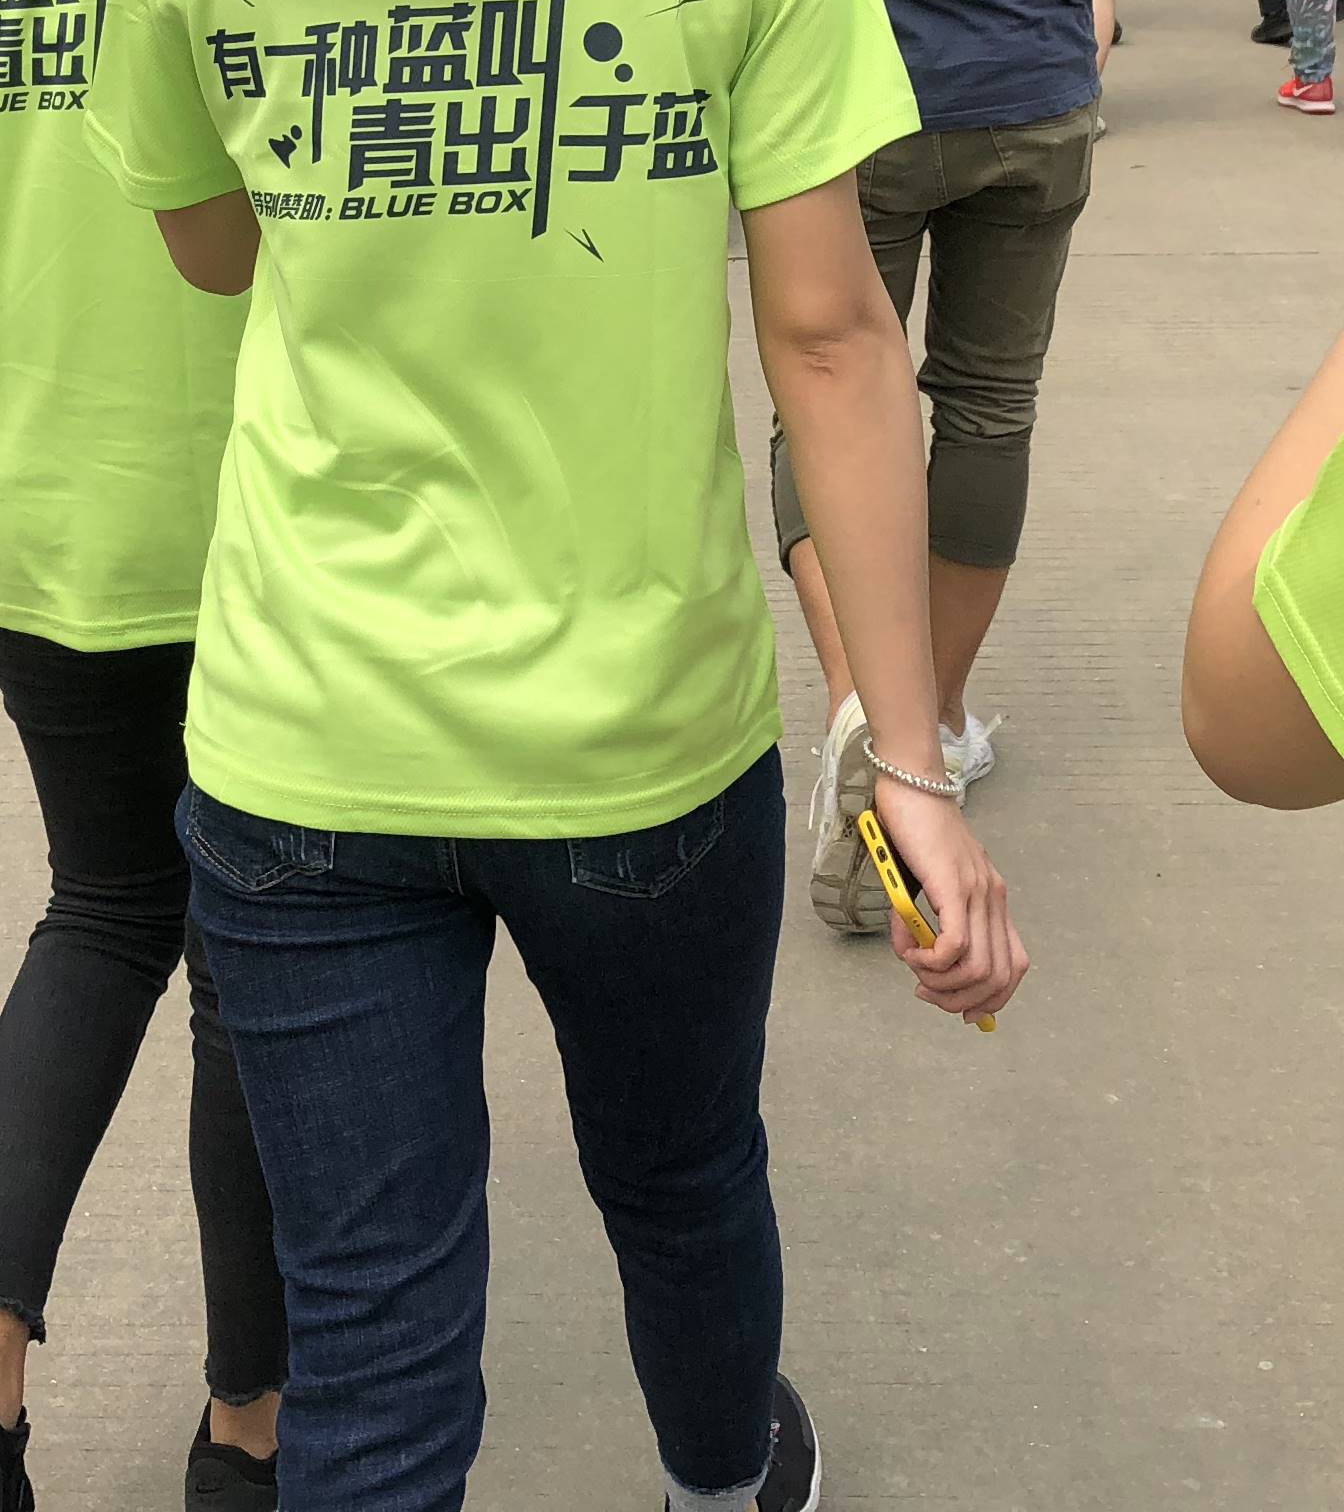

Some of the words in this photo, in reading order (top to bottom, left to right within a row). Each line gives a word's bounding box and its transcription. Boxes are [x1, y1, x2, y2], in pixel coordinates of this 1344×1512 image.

[38, 90, 89, 111] BOX
[339, 193, 437, 221] BLUE
[448, 188, 533, 216] BOX
